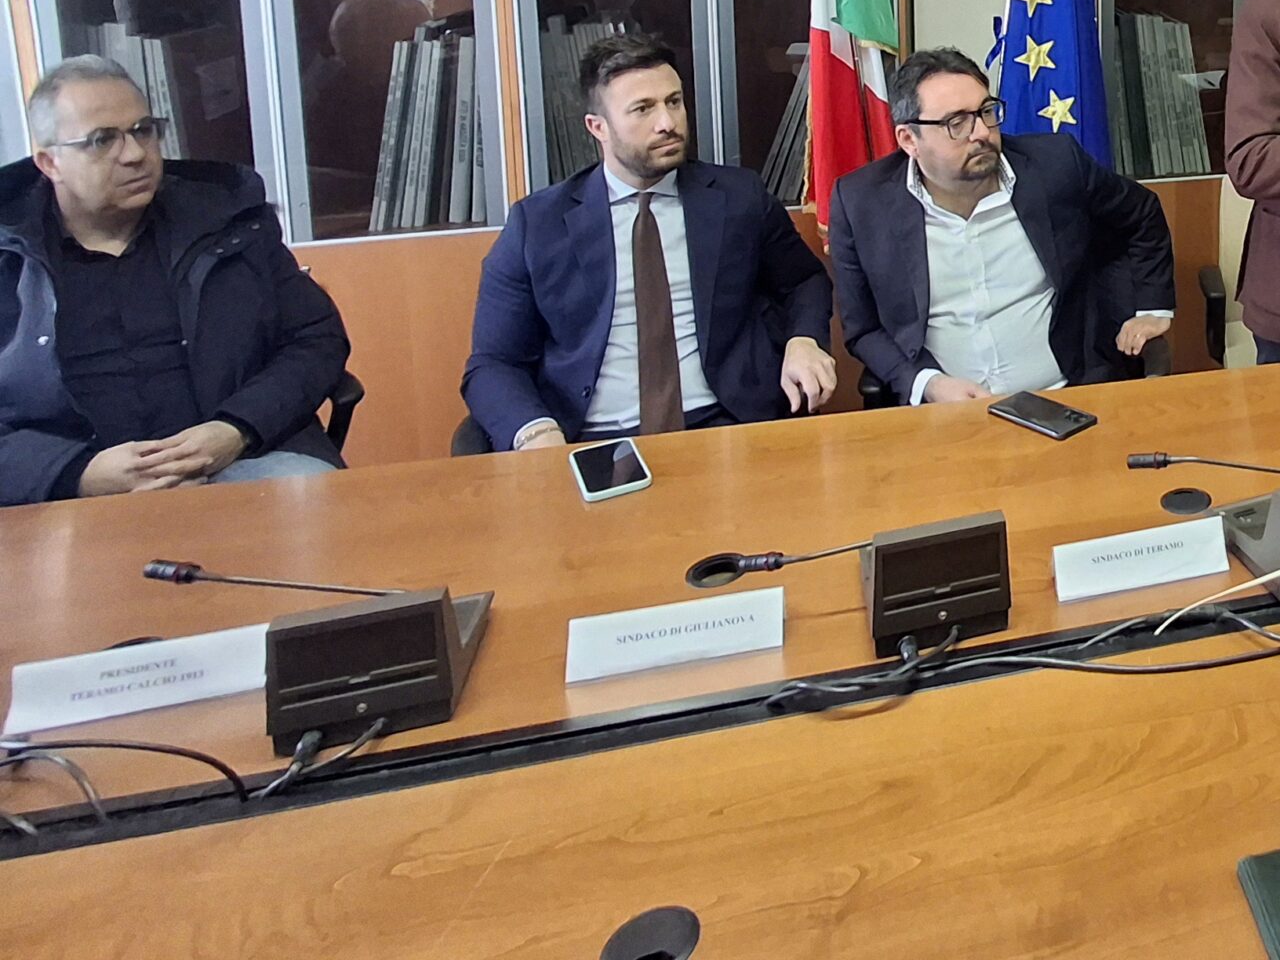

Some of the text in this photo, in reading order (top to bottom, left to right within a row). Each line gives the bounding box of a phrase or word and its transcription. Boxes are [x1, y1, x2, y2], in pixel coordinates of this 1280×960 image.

[1091, 541, 1184, 565] SINDACO DI TERAMO
[615, 613, 756, 646] SINDACO DI GIULIANOVA
[99, 659, 177, 680] PRESIDENTE
[70, 669, 205, 702] TERAMO CALCIO 1913
